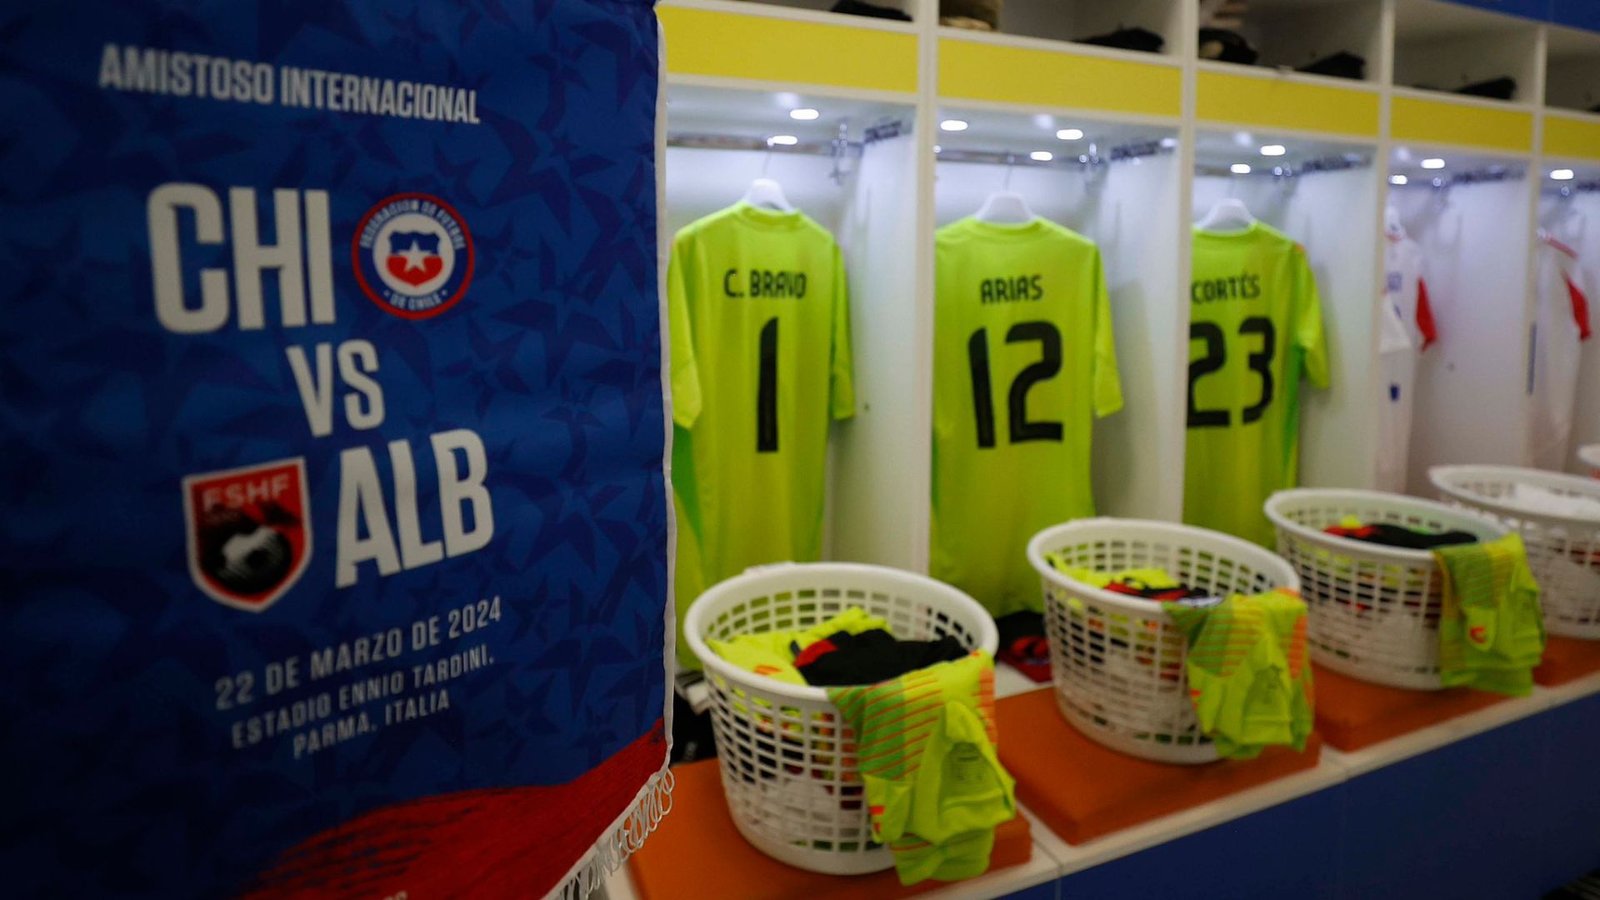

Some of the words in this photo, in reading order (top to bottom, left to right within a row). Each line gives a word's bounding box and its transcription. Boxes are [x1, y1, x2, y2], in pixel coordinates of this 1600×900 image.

[99, 44, 273, 105] AMISTOSO
[281, 66, 480, 125] INTERNACIONAL
[147, 183, 336, 334] CHI
[724, 269, 743, 297] C.
[750, 269, 807, 299] BRAVO
[981, 274, 1043, 304] ARIAS
[1191, 274, 1261, 303] CORTÉS
[287, 340, 385, 438] VS
[756, 316, 779, 453] 1
[968, 321, 1064, 449] 12
[1187, 315, 1275, 428] 23
[203, 474, 289, 513] FSHF
[336, 429, 494, 588] ALB
[215, 670, 254, 710] 22
[265, 656, 300, 695] DE
[310, 628, 402, 680] MARZO
[412, 615, 440, 650] DE
[448, 596, 502, 639] 2024
[231, 693, 331, 748] ESTADIO
[339, 671, 404, 711] ENNIO
[385, 689, 450, 726] ITALIA
